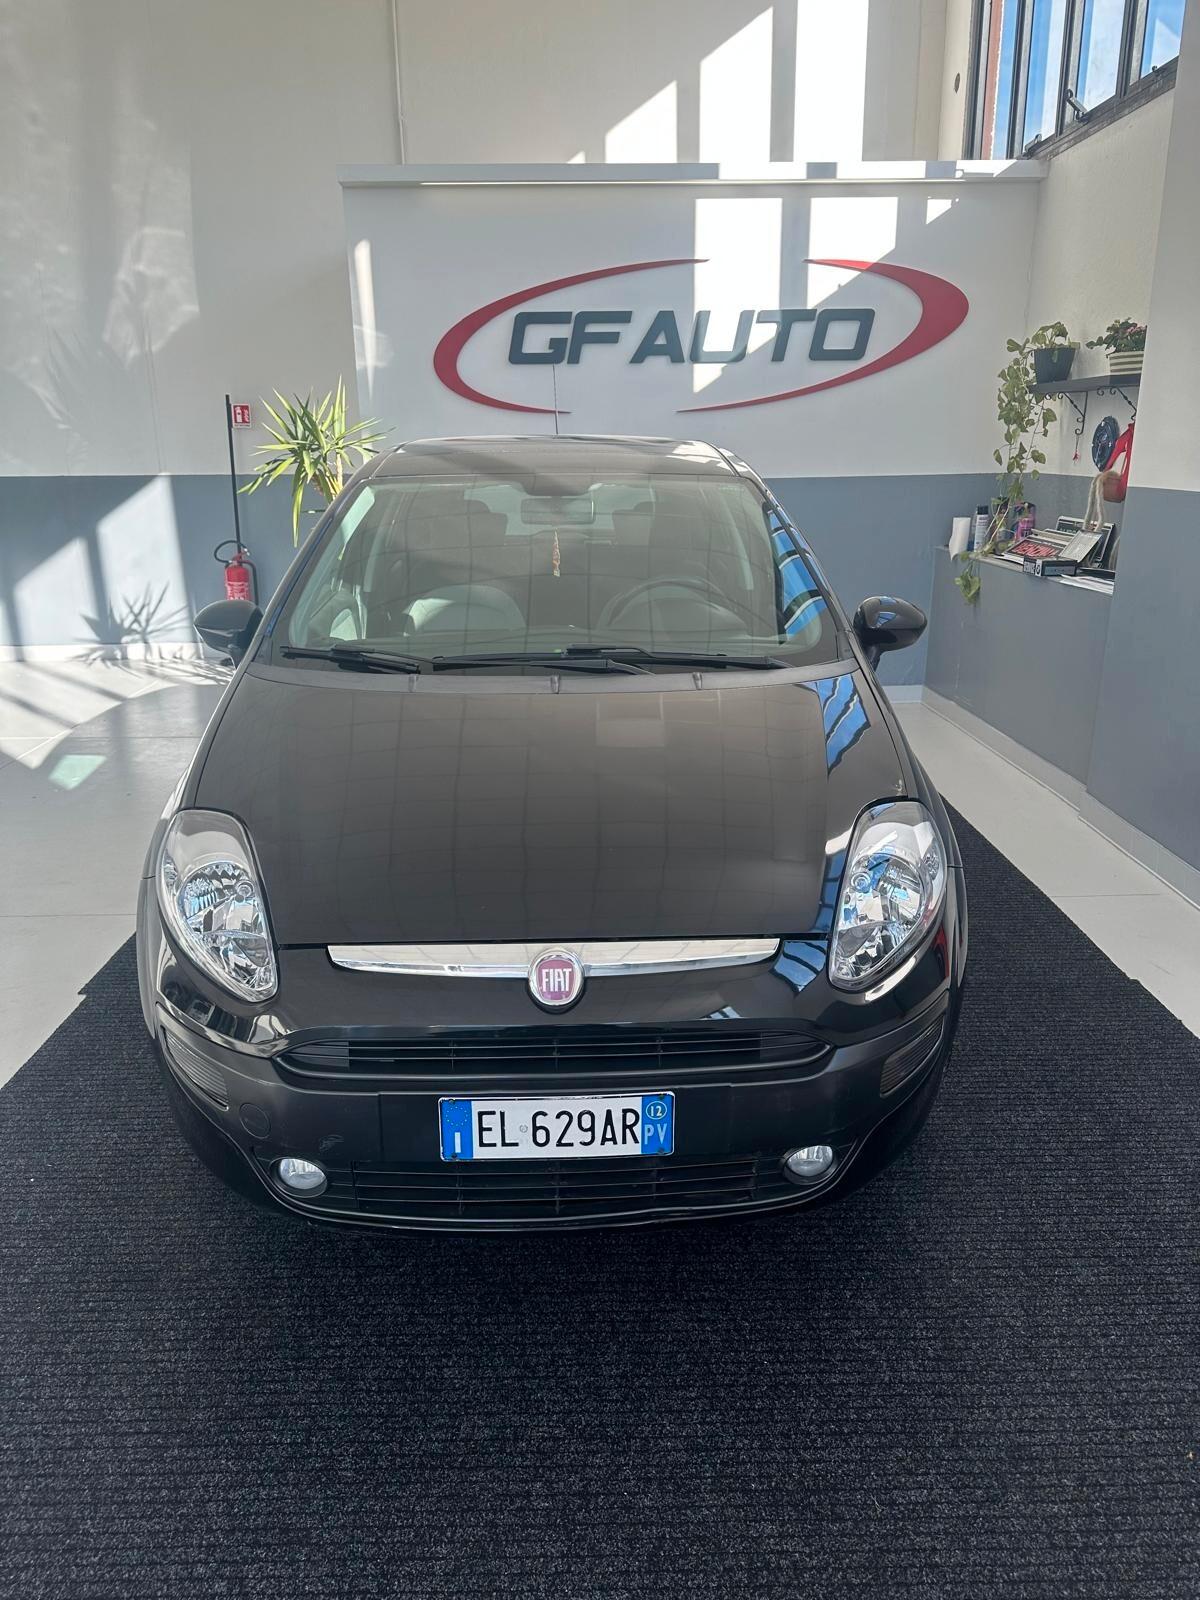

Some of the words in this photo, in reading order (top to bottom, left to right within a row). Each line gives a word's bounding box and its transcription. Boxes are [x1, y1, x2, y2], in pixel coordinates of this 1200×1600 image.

[541, 968, 572, 992] FIAT
[650, 1105, 662, 1118] 12
[477, 1110, 520, 1147] EL
[531, 1108, 640, 1147] 629AR
[644, 1123, 668, 1145] PV
[454, 1132, 462, 1153] I
